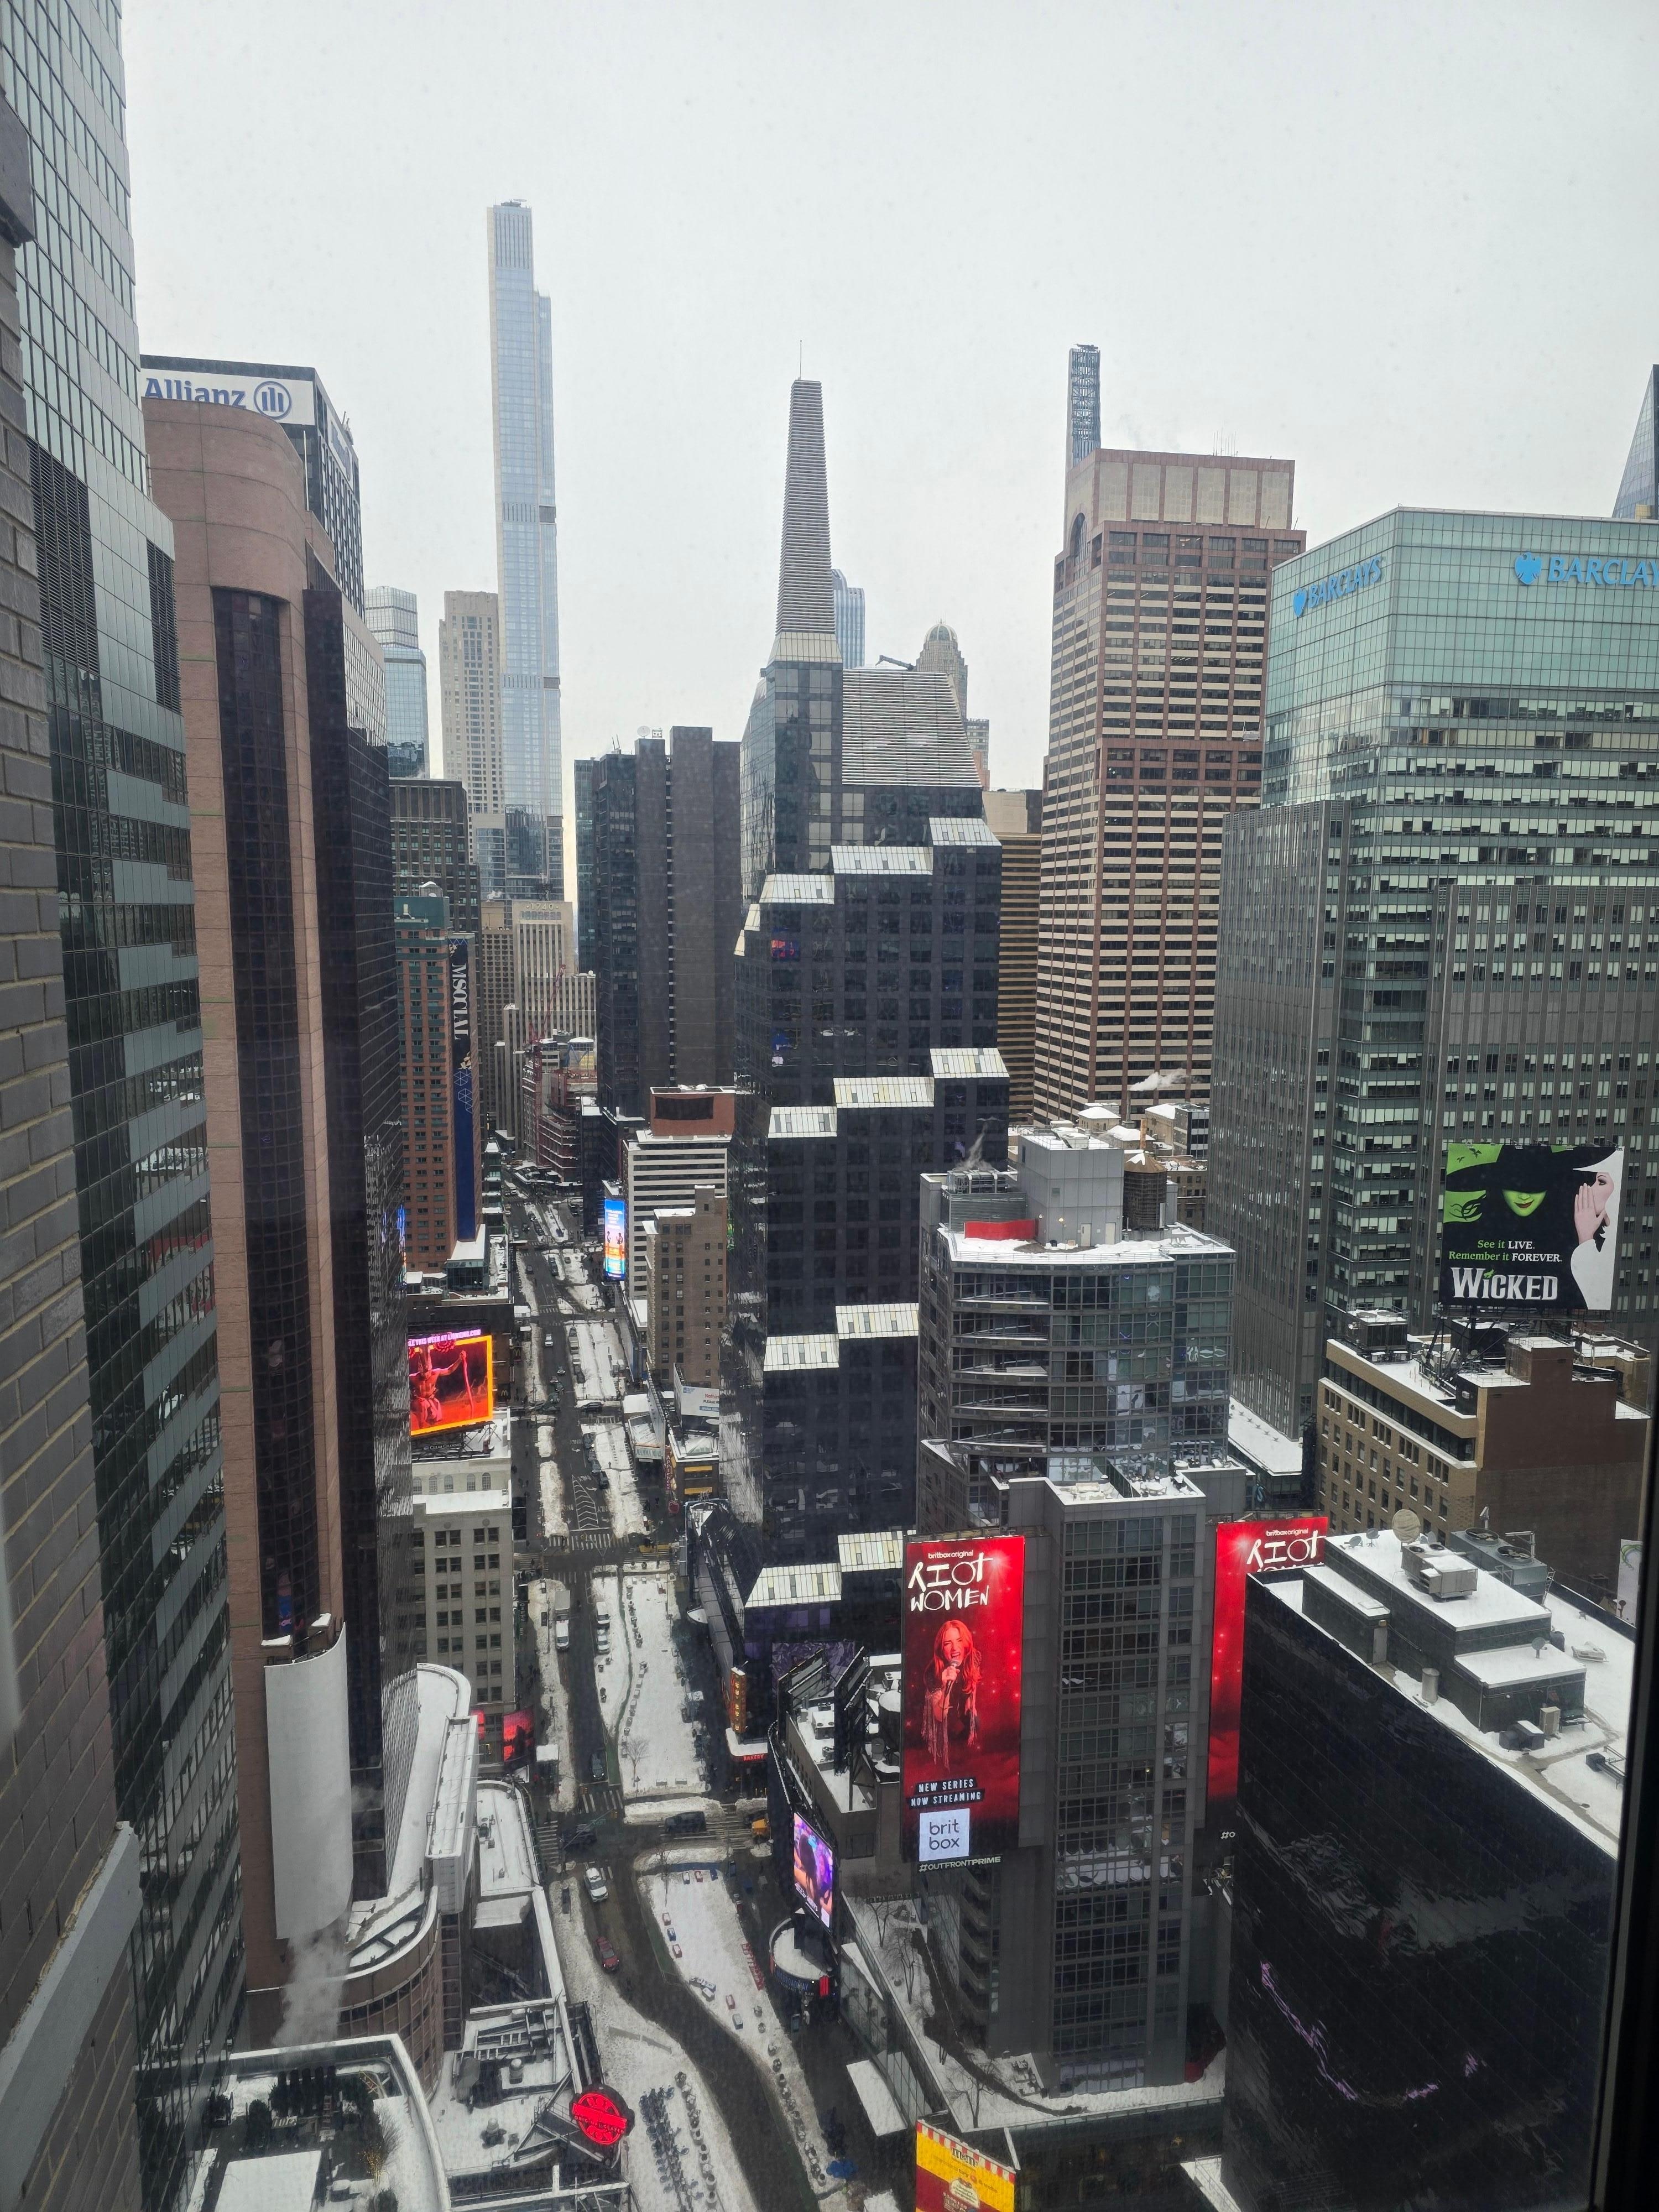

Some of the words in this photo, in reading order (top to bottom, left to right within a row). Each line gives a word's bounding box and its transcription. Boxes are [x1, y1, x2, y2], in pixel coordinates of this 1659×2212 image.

[144, 378, 247, 409] Allianz
[1307, 555, 1382, 608] BARCLAYS
[1477, 1240, 1495, 1249] See
[1498, 1240, 1505, 1249] it
[1507, 1241, 1535, 1250] LIVE.
[1448, 1251, 1500, 1261] Remember
[1502, 1251, 1510, 1261] it
[1511, 1254, 1563, 1262] FOREVER.
[951, 1550, 974, 1558] original
[1246, 1530, 1327, 1568] RIOT
[907, 1552, 993, 1593] RIOT
[911, 1585, 989, 1611] WOMEN
[919, 1782, 937, 1793] NEW
[942, 1778, 974, 1791] SERIES
[911, 1797, 928, 1807] NOW
[933, 1791, 981, 1804] STREAMING
[929, 1819, 959, 1835] brit
[929, 1837, 960, 1850] box
[919, 1856, 1001, 1872] #OUTFRONTPRIME
